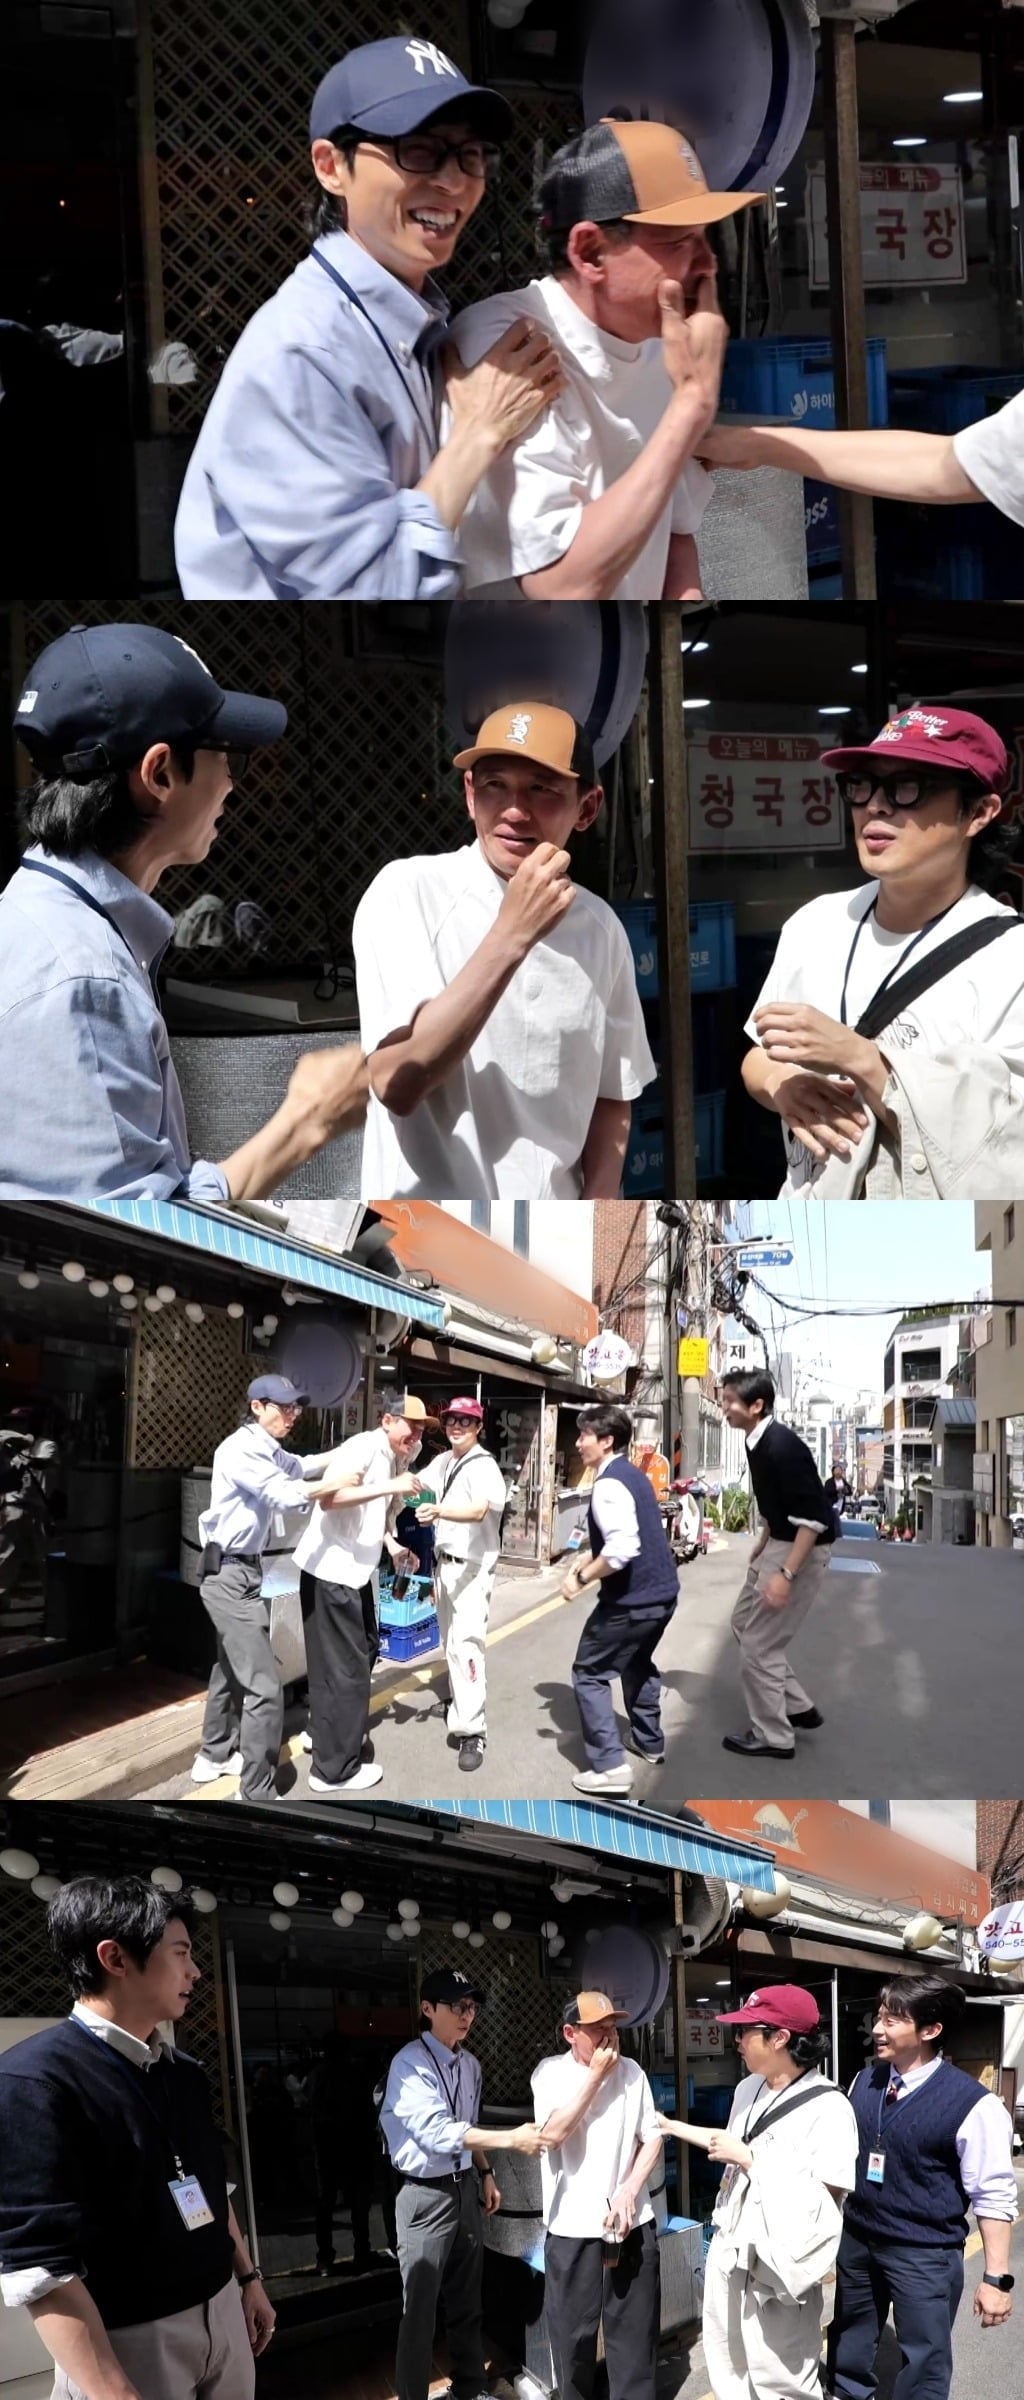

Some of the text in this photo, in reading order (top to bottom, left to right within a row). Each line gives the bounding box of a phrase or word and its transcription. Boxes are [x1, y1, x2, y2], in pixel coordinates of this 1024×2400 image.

[405, 40, 458, 78] NY
[899, 168, 931, 190] 메뉴
[875, 207, 957, 260] 국장
[810, 391, 835, 413] 하이
[907, 710, 949, 727] Better
[719, 738, 810, 760] 오늘의 메뉴
[700, 774, 836, 829] 청국장
[690, 2025, 720, 2046] 국장
